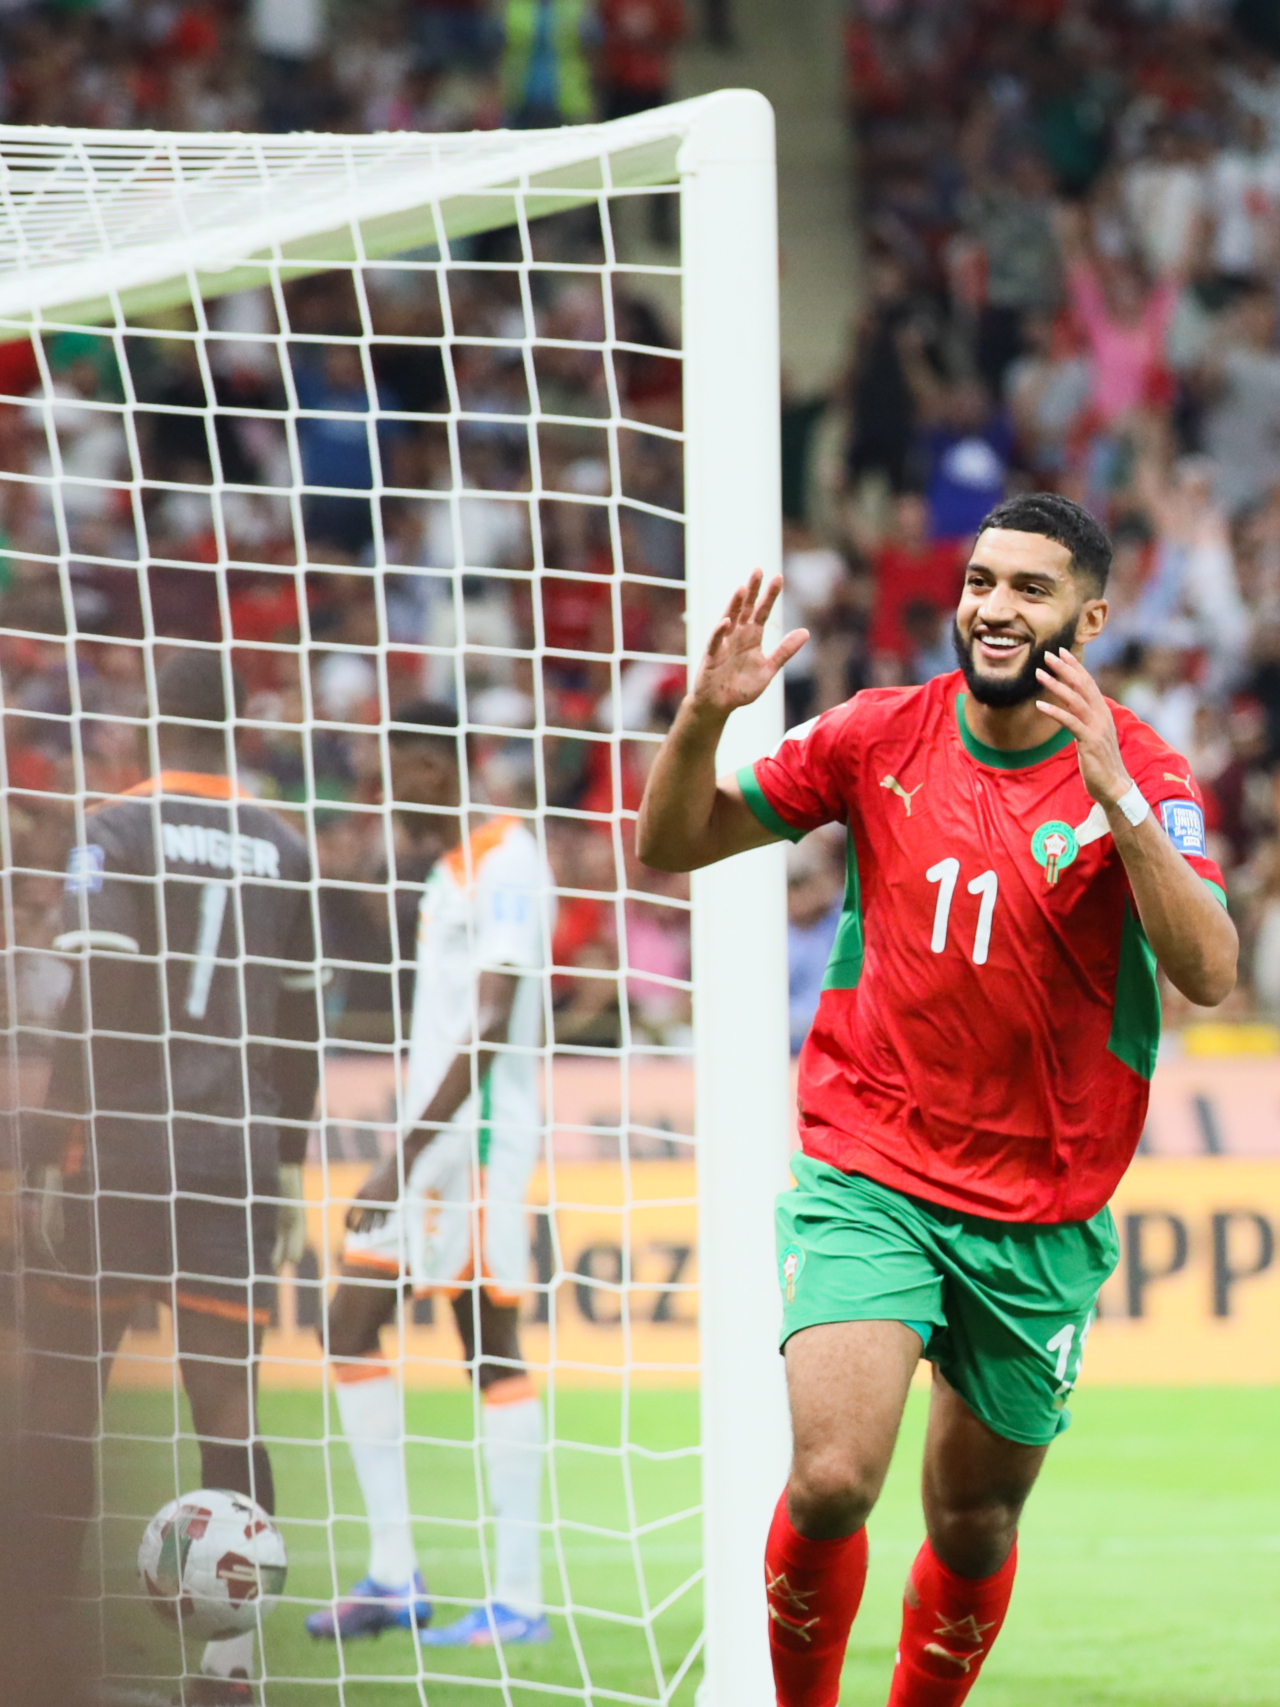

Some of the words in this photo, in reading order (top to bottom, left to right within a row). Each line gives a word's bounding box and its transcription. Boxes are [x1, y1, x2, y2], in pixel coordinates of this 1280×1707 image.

[161, 822, 281, 880] NIGER
[185, 883, 228, 1020] 1
[925, 857, 998, 965] 11
